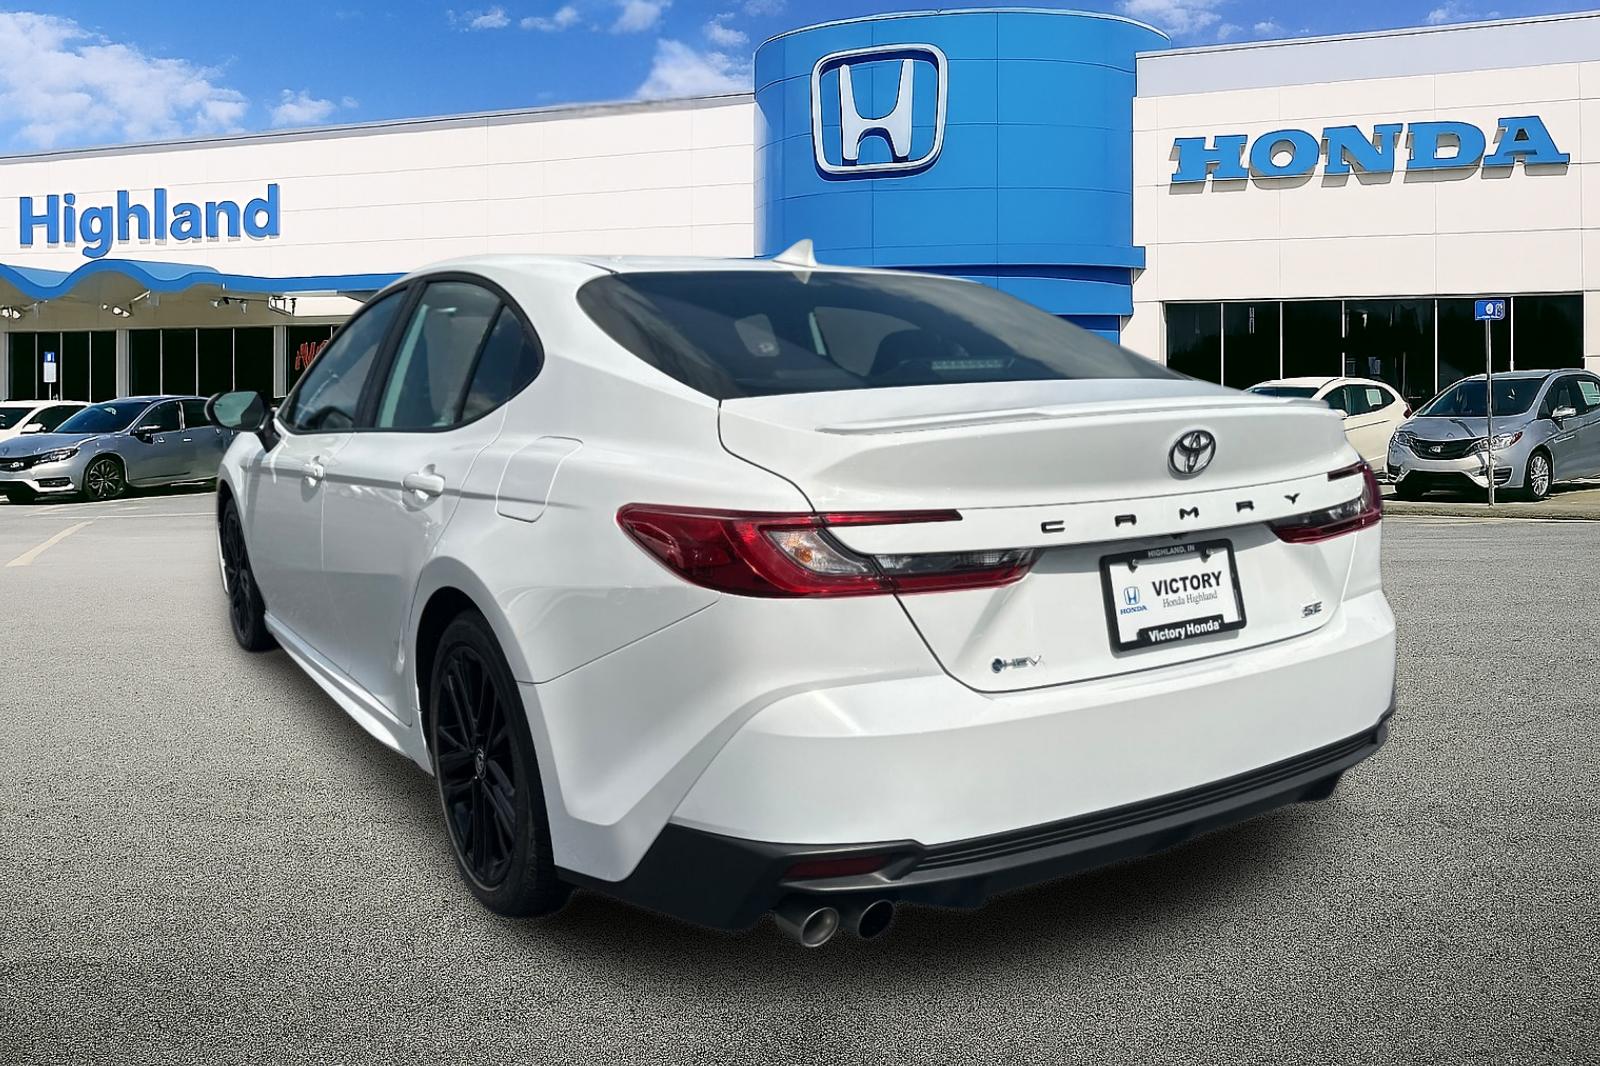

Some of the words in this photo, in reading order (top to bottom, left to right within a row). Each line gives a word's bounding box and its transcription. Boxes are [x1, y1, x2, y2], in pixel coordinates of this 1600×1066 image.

[1171, 115, 1570, 182] HONDA
[19, 183, 280, 258] Highland
[1041, 493, 1300, 533] CAMRY
[1187, 544, 1195, 552] IN
[1152, 571, 1222, 597] VICTORY
[1162, 595, 1185, 608] Honda
[1186, 590, 1218, 605] Highland
[1120, 605, 1148, 615] HONDA
[1302, 601, 1322, 617] SE
[1148, 626, 1186, 642] Victory
